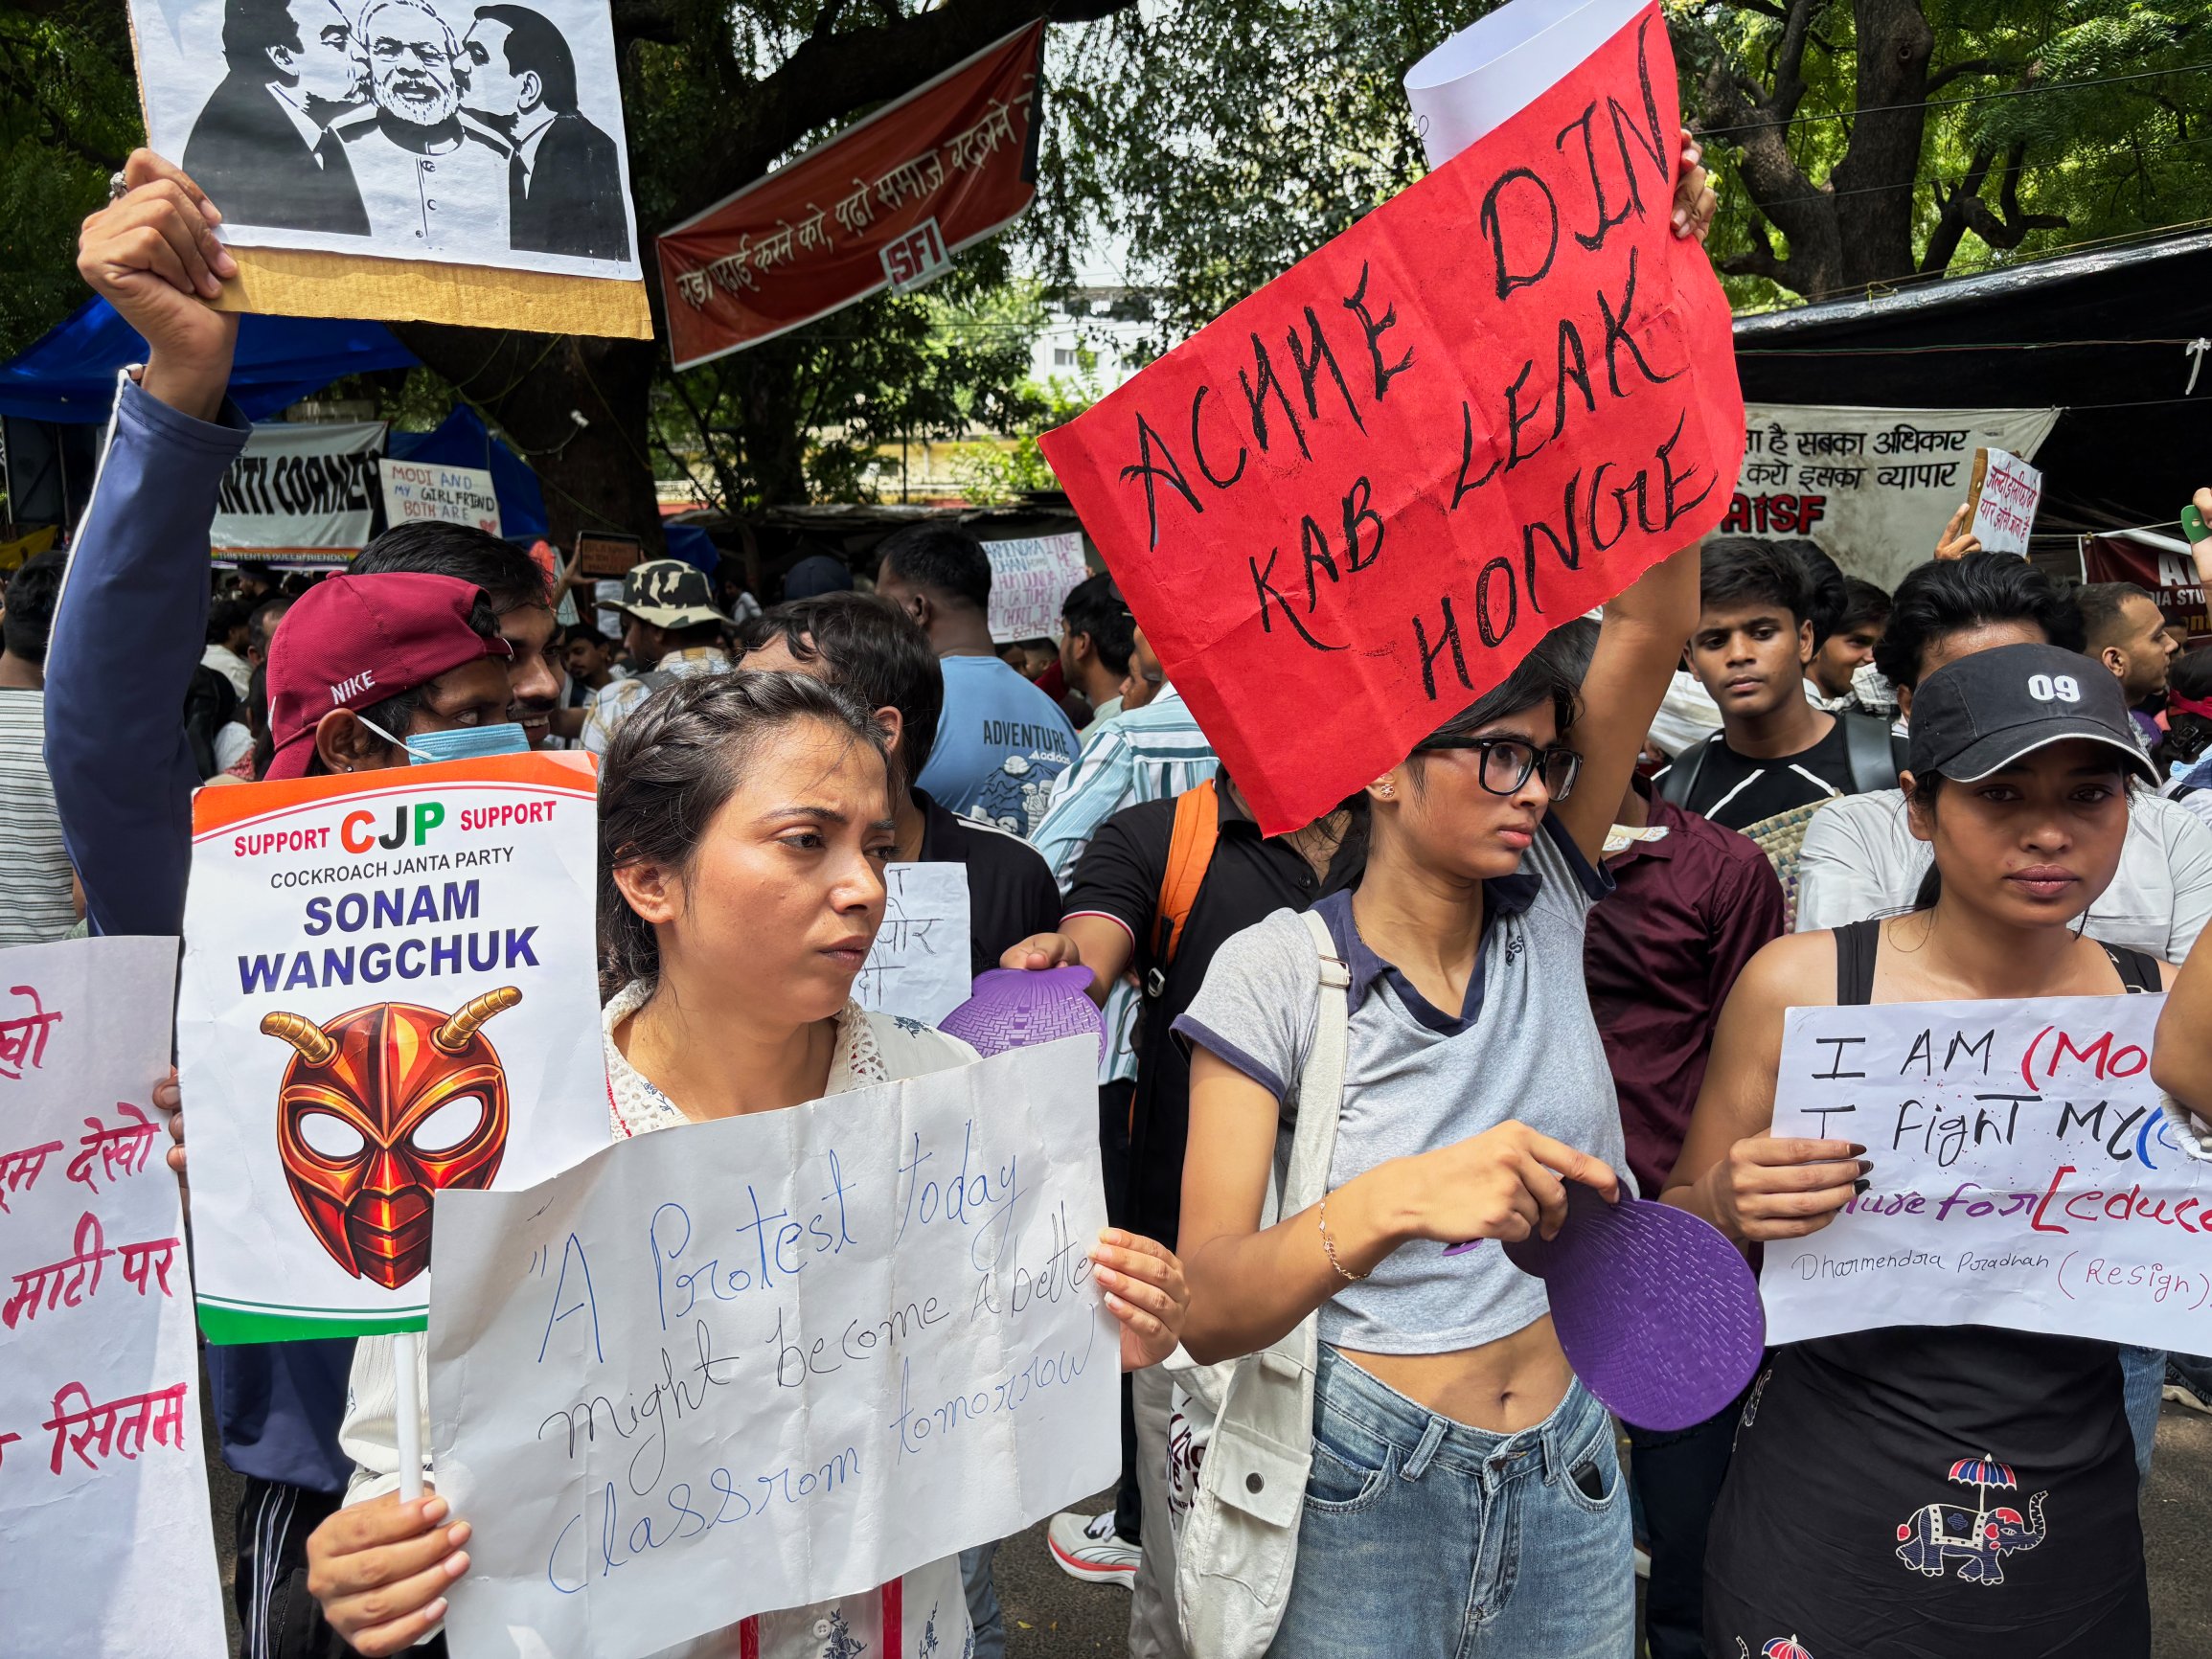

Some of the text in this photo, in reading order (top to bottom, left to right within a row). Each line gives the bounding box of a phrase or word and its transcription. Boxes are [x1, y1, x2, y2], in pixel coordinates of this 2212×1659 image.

[1480, 13, 1671, 301] DIN
[753, 219, 795, 274] करने
[874, 148, 945, 209] समाज
[886, 224, 943, 284] SFI
[1249, 246, 1694, 652] KAB LEAK
[1768, 422, 1789, 456] है
[1794, 432, 1868, 456] सबका
[1872, 423, 1971, 455] अधिकार
[391, 466, 472, 490] MODI AND
[395, 485, 411, 497] MY
[1746, 459, 1793, 486] करो
[1798, 466, 1868, 492] इसका
[1877, 462, 1960, 490] व्यापार
[404, 500, 470, 520] BOTH ARE
[1411, 407, 1721, 700] HONGE
[331, 670, 376, 705] NIKE
[2028, 674, 2081, 702] 09
[983, 719, 1070, 755] ADVENTURE
[1039, 750, 1072, 765] adidas
[233, 801, 558, 858] SUPPORT CJP SUPPORT
[270, 846, 515, 889] COCKROACH JANTA PARTY
[303, 879, 481, 937] SONAM
[238, 925, 540, 995] WANGCHUK
[1811, 1036, 1866, 1080] I
[1900, 1028, 1995, 1077] AM
[66, 1102, 162, 1195] देखो
[650, 1148, 857, 1331] Protest
[2, 1210, 181, 1330] माटी पर
[538, 1318, 741, 1496] might
[764, 1307, 950, 1388] become
[1012, 1199, 1096, 1318] bette
[889, 1302, 1096, 1466] tomorrow
[42, 1380, 188, 1476] सितम
